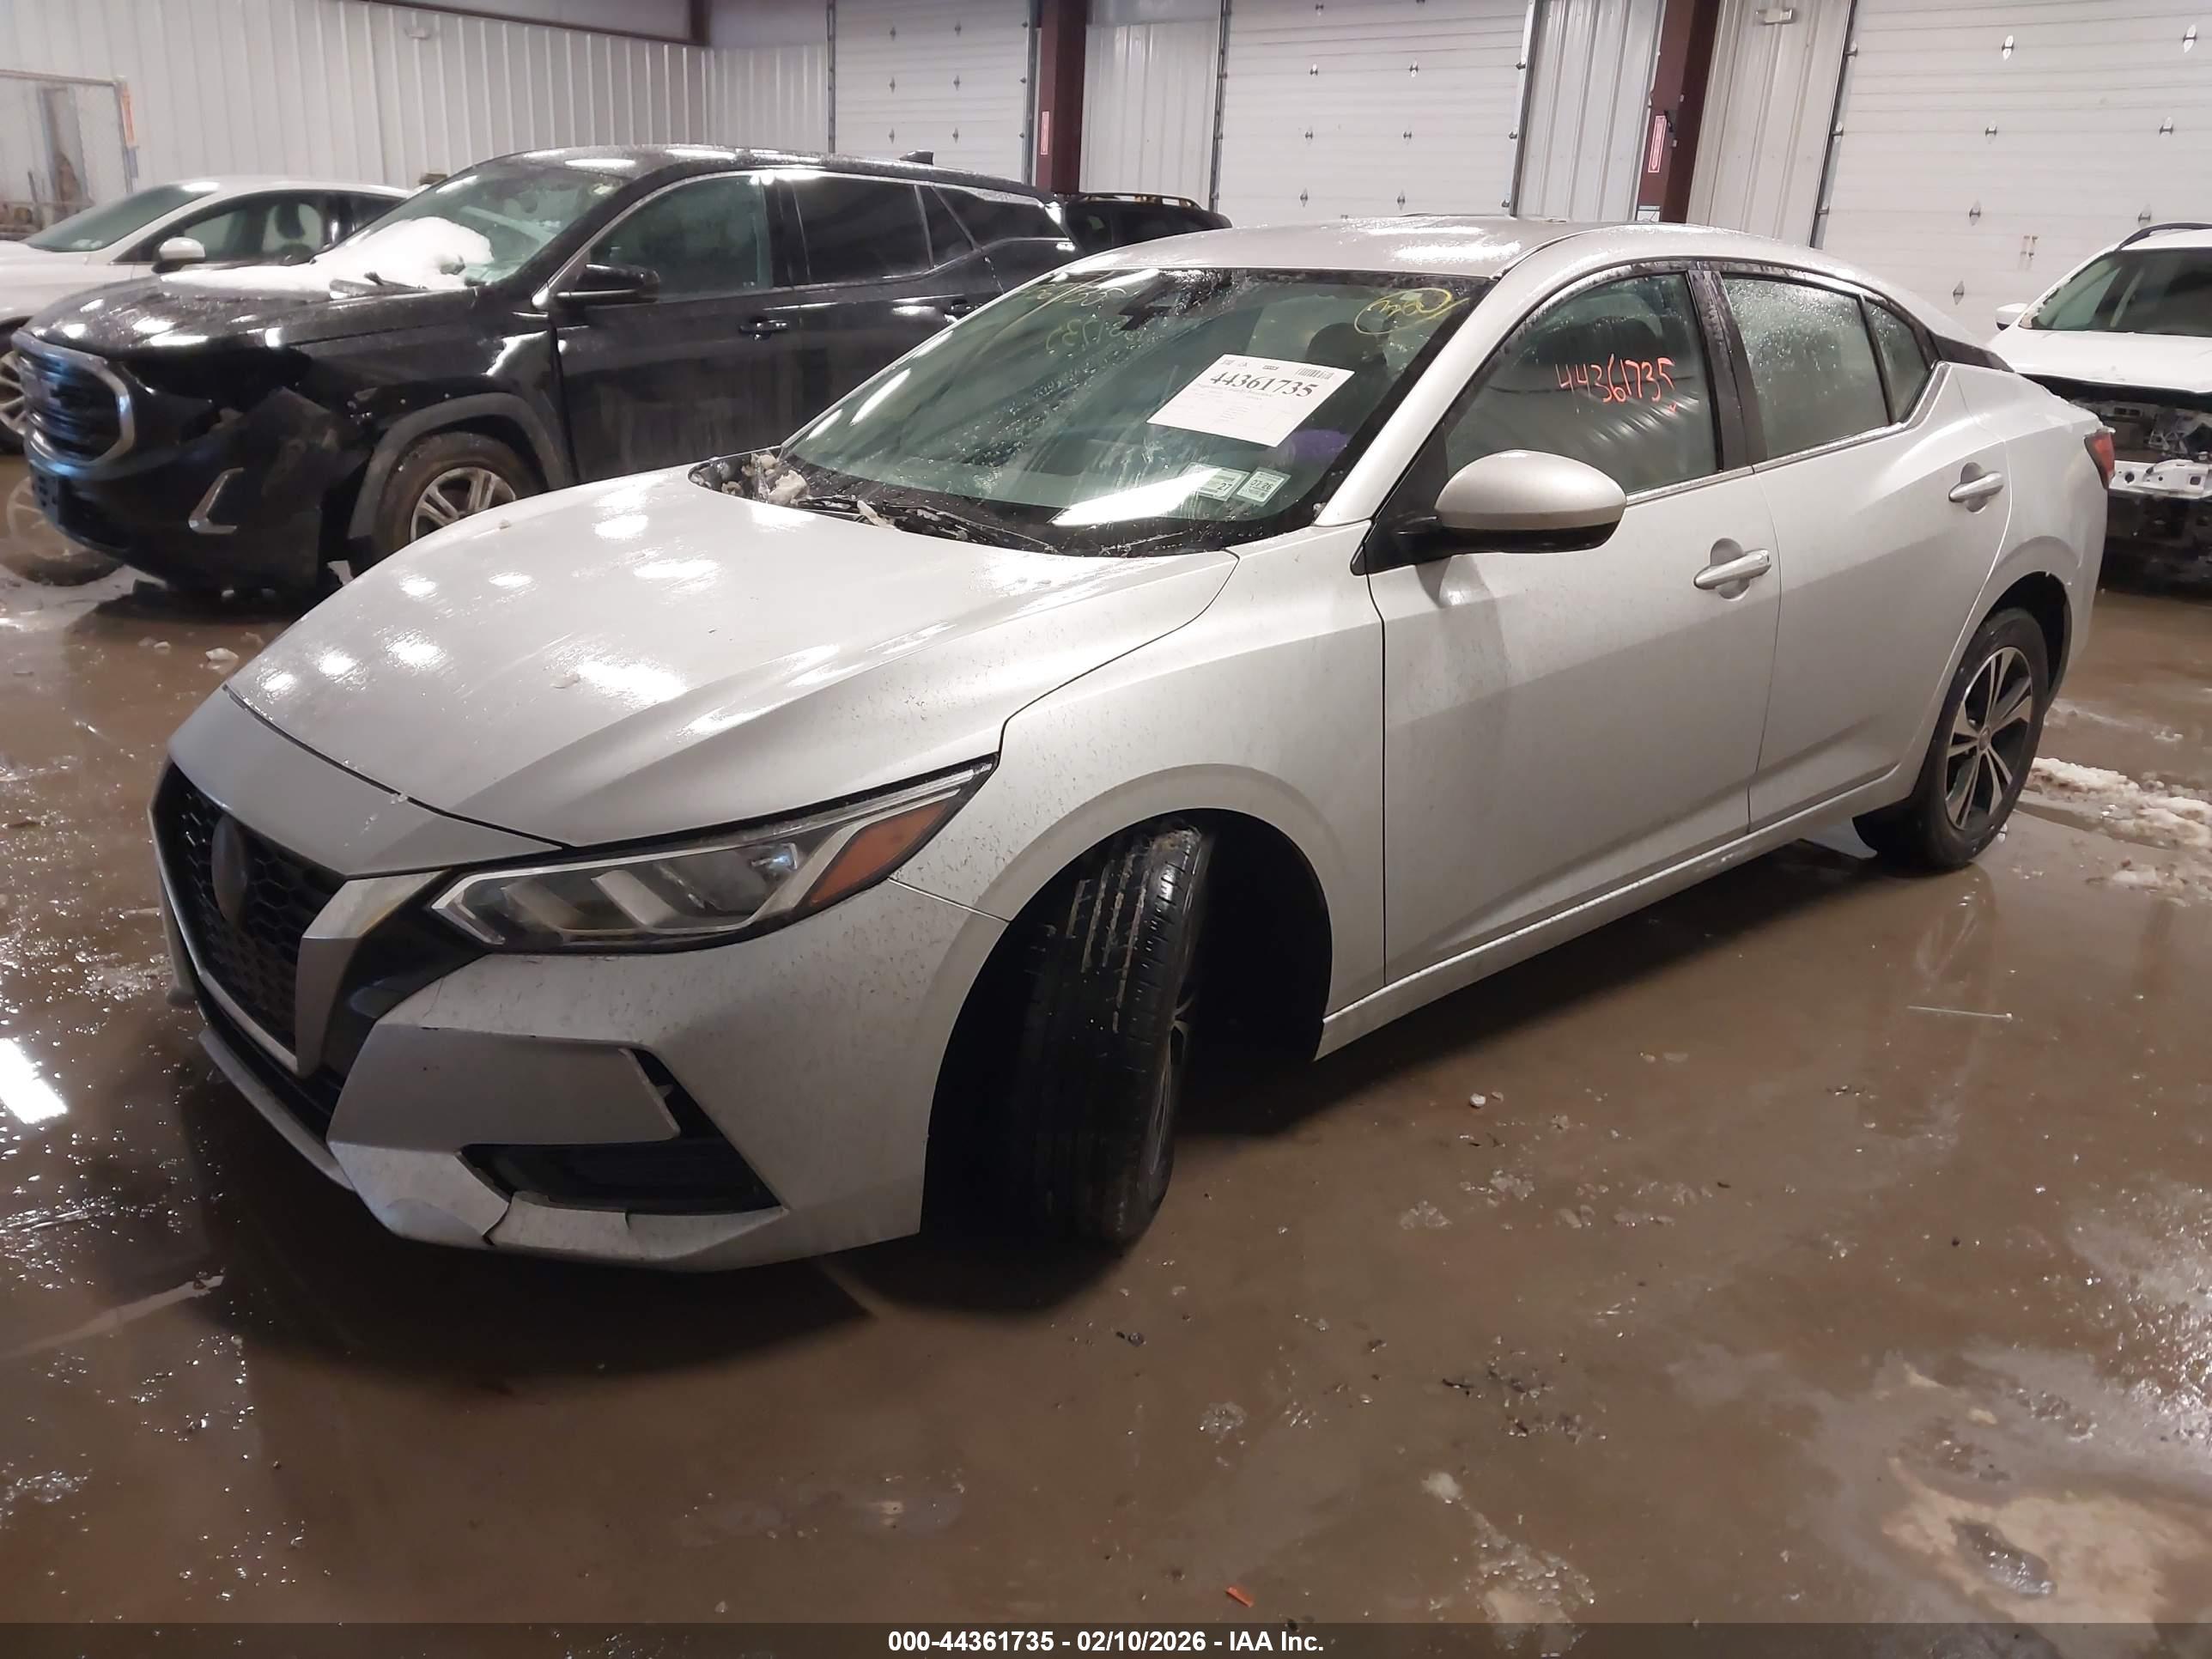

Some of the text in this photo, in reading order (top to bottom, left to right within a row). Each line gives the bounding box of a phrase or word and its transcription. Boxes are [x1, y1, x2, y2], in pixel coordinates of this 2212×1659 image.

[1210, 371, 1319, 398] 44361735
[1555, 353, 1675, 403] 44361735
[1217, 483, 1232, 491] 27
